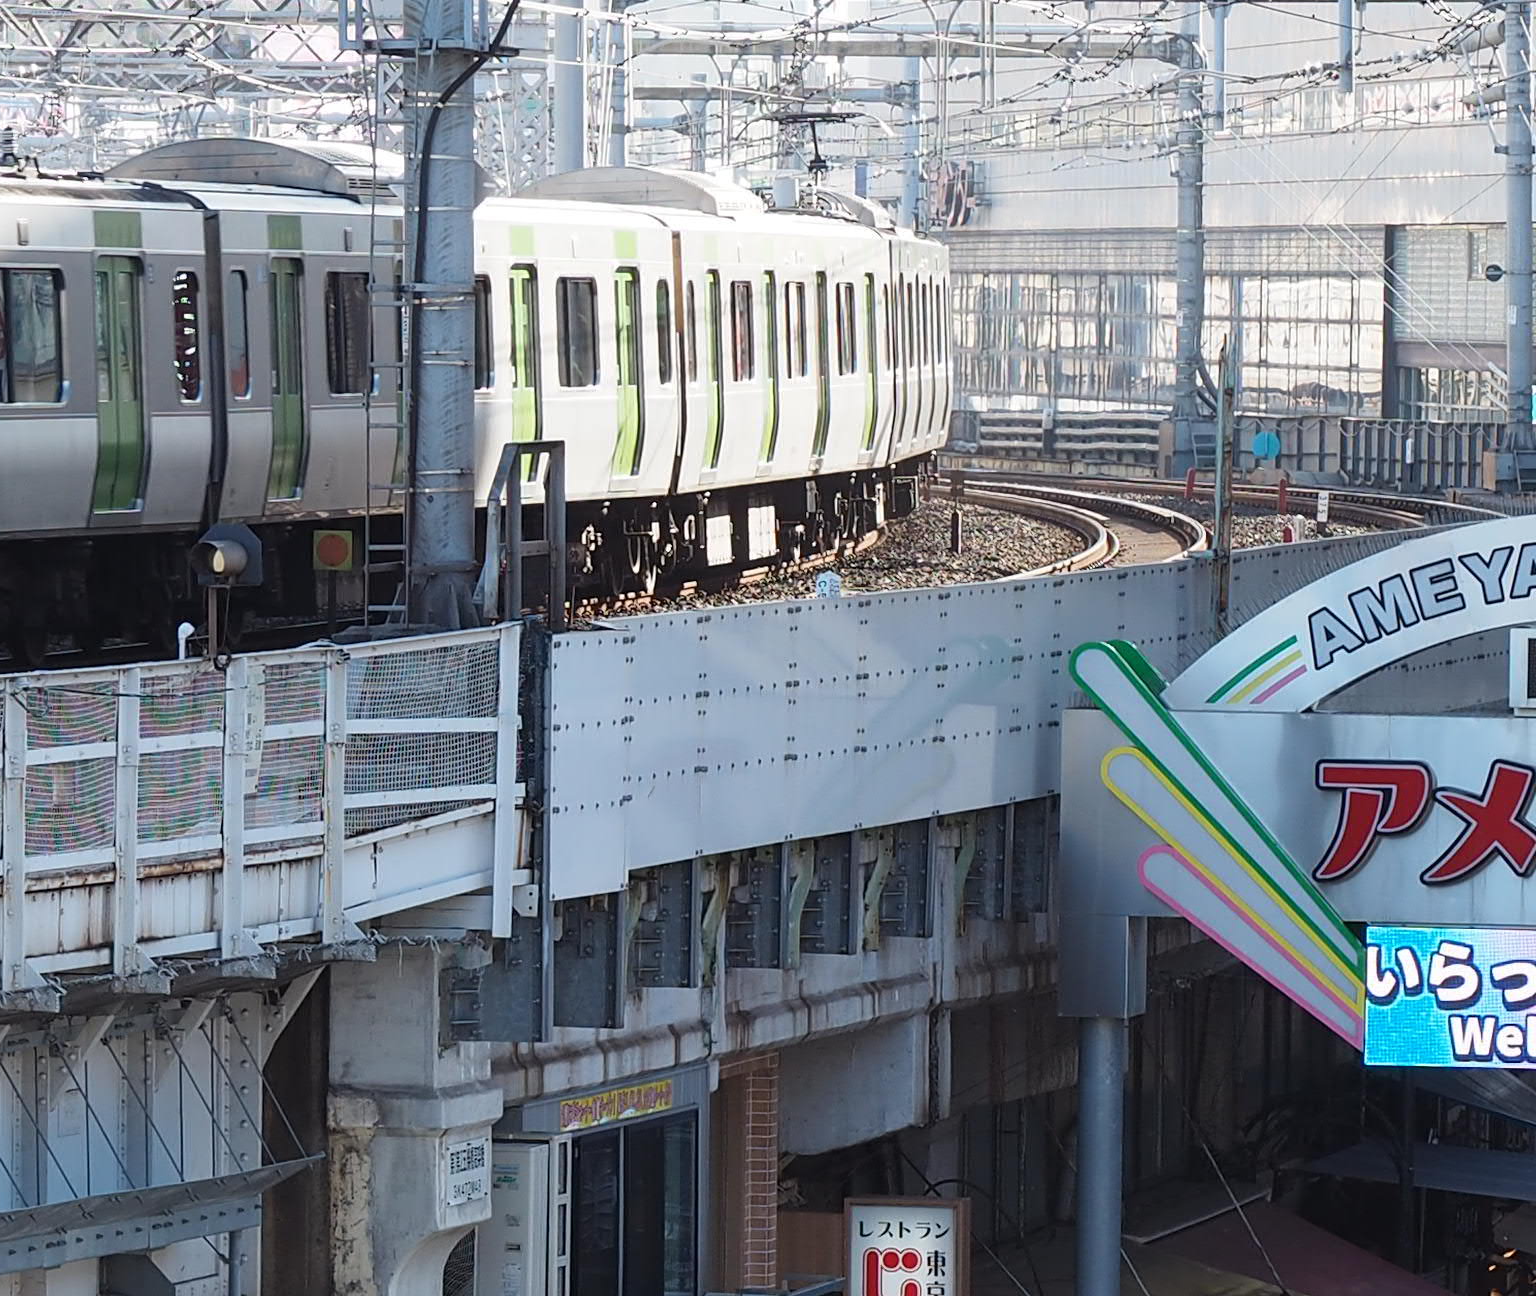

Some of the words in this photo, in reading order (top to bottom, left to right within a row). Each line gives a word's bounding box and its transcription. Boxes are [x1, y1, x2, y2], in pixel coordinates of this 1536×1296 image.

[858, 1220, 951, 1240] レストラン
